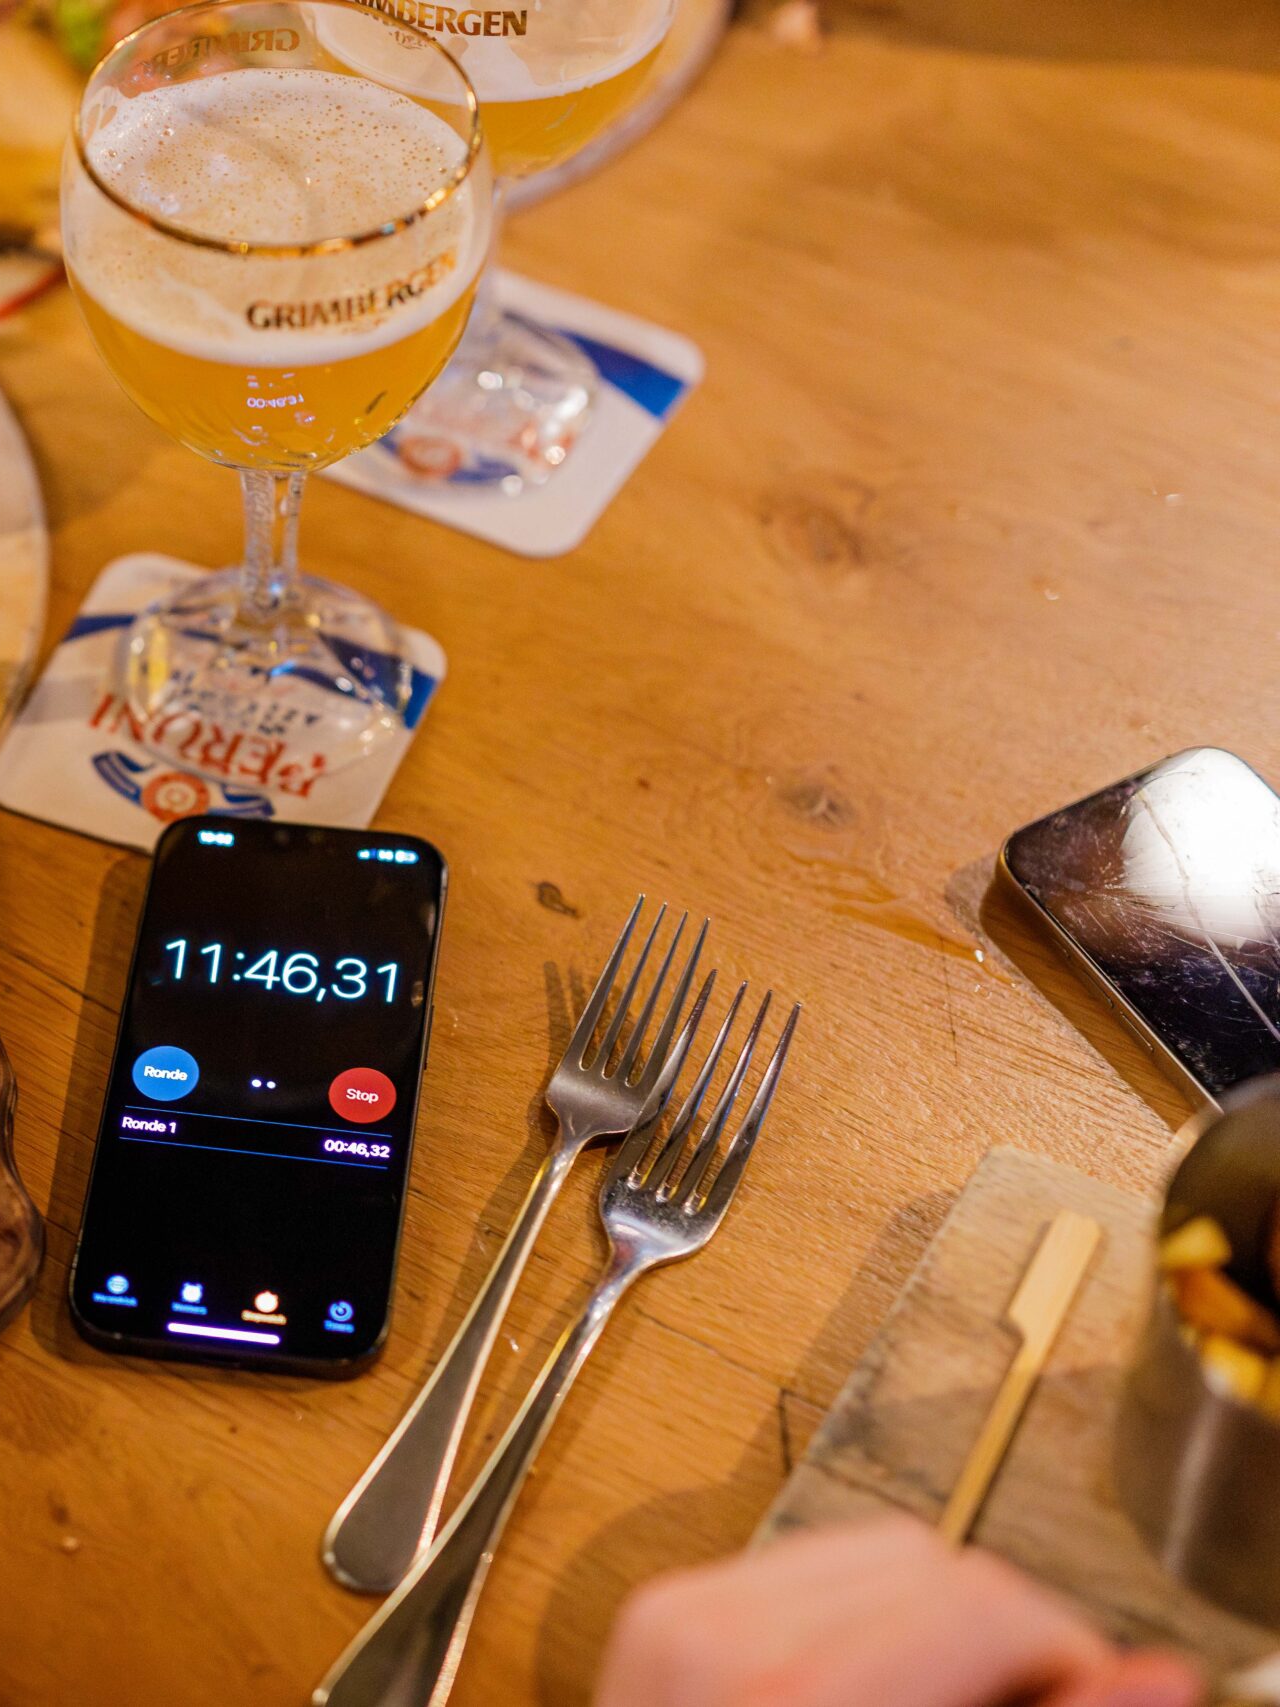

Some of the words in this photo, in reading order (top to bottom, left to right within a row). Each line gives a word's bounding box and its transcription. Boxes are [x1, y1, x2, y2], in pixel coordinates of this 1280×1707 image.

[246, 249, 456, 330] GRIMBERGEN
[166, 939, 398, 1003] 11:46,31
[143, 1065, 188, 1081] Ronde
[345, 1088, 379, 1104] Stop
[121, 1116, 167, 1132] Ronde
[168, 1121, 177, 1134] 1
[324, 1139, 390, 1158] 00:46,32
